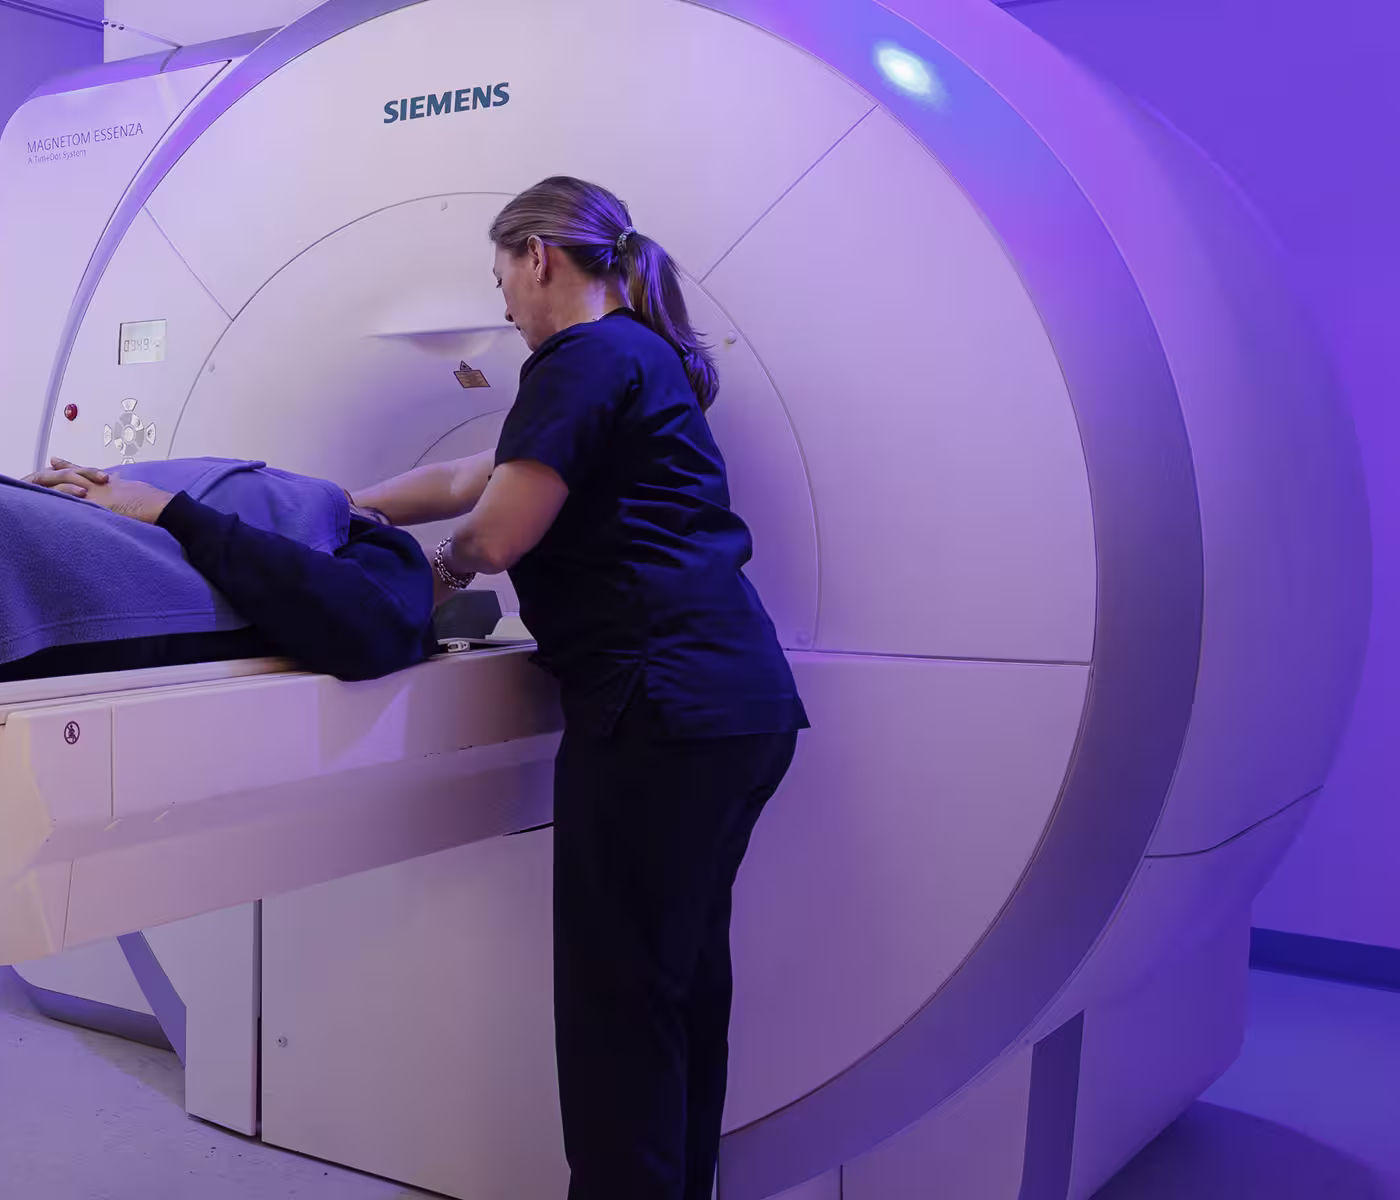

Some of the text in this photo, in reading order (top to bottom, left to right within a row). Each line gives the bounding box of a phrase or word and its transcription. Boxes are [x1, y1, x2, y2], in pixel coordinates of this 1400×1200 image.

[383, 82, 510, 124] SIEMENS
[27, 123, 144, 153] MAGNETOM ESSENZA
[62, 149, 87, 160] System
